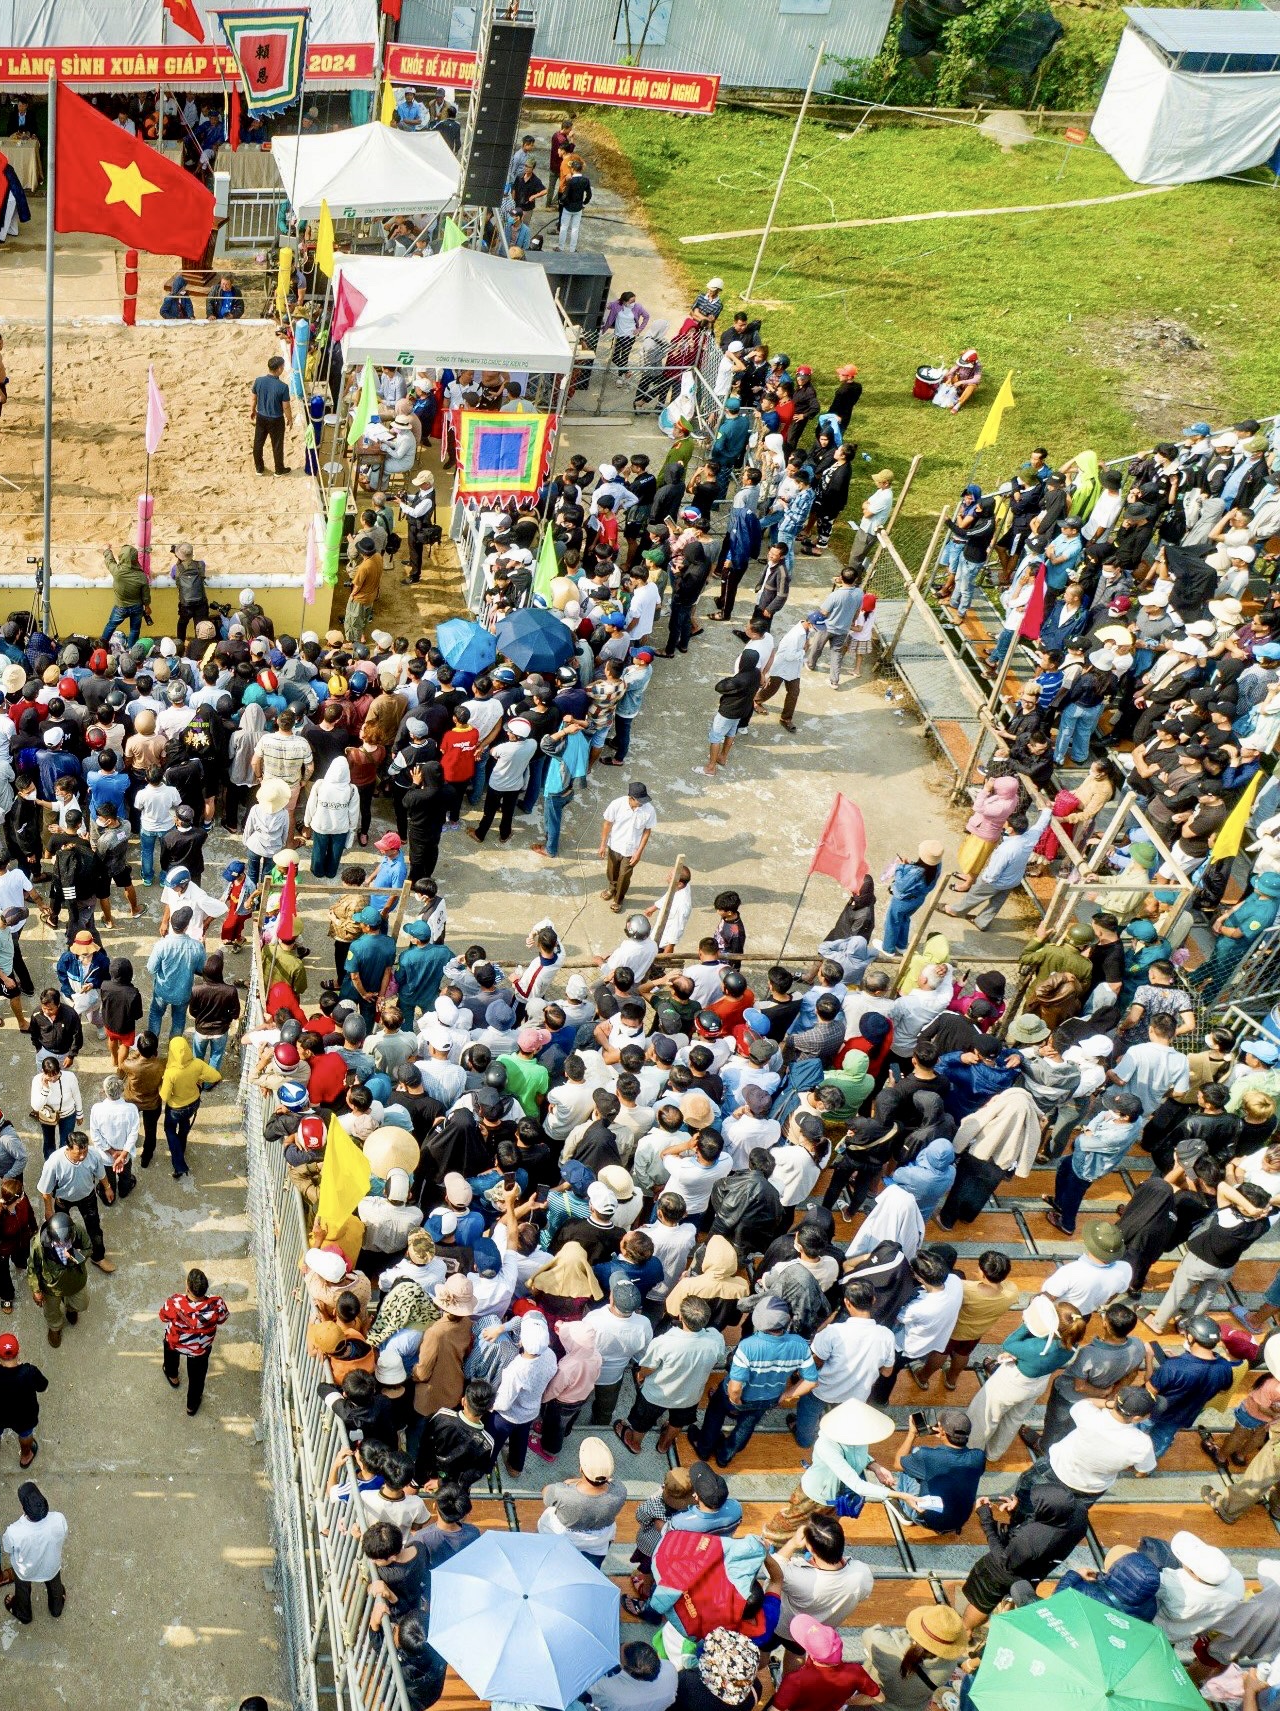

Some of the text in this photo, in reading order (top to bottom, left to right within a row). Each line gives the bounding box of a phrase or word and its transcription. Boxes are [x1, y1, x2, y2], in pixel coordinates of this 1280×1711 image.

[7, 52, 56, 76] LÀNG
[62, 52, 106, 76] SÌNH
[111, 53, 159, 76] XUÂN
[165, 52, 207, 75] GIÁP
[309, 53, 358, 73] 2024
[400, 54, 424, 76] KHỎE
[439, 56, 458, 78] XÂY
[533, 63, 549, 88] TỔ
[545, 66, 571, 92] QUỐC
[571, 71, 593, 96] VIỆT
[594, 77, 617, 95] NAM
[617, 74, 632, 97] XÃ
[632, 77, 649, 101] HỘI
[650, 77, 670, 101] CHỦ
[670, 80, 702, 104] NGHĨA
